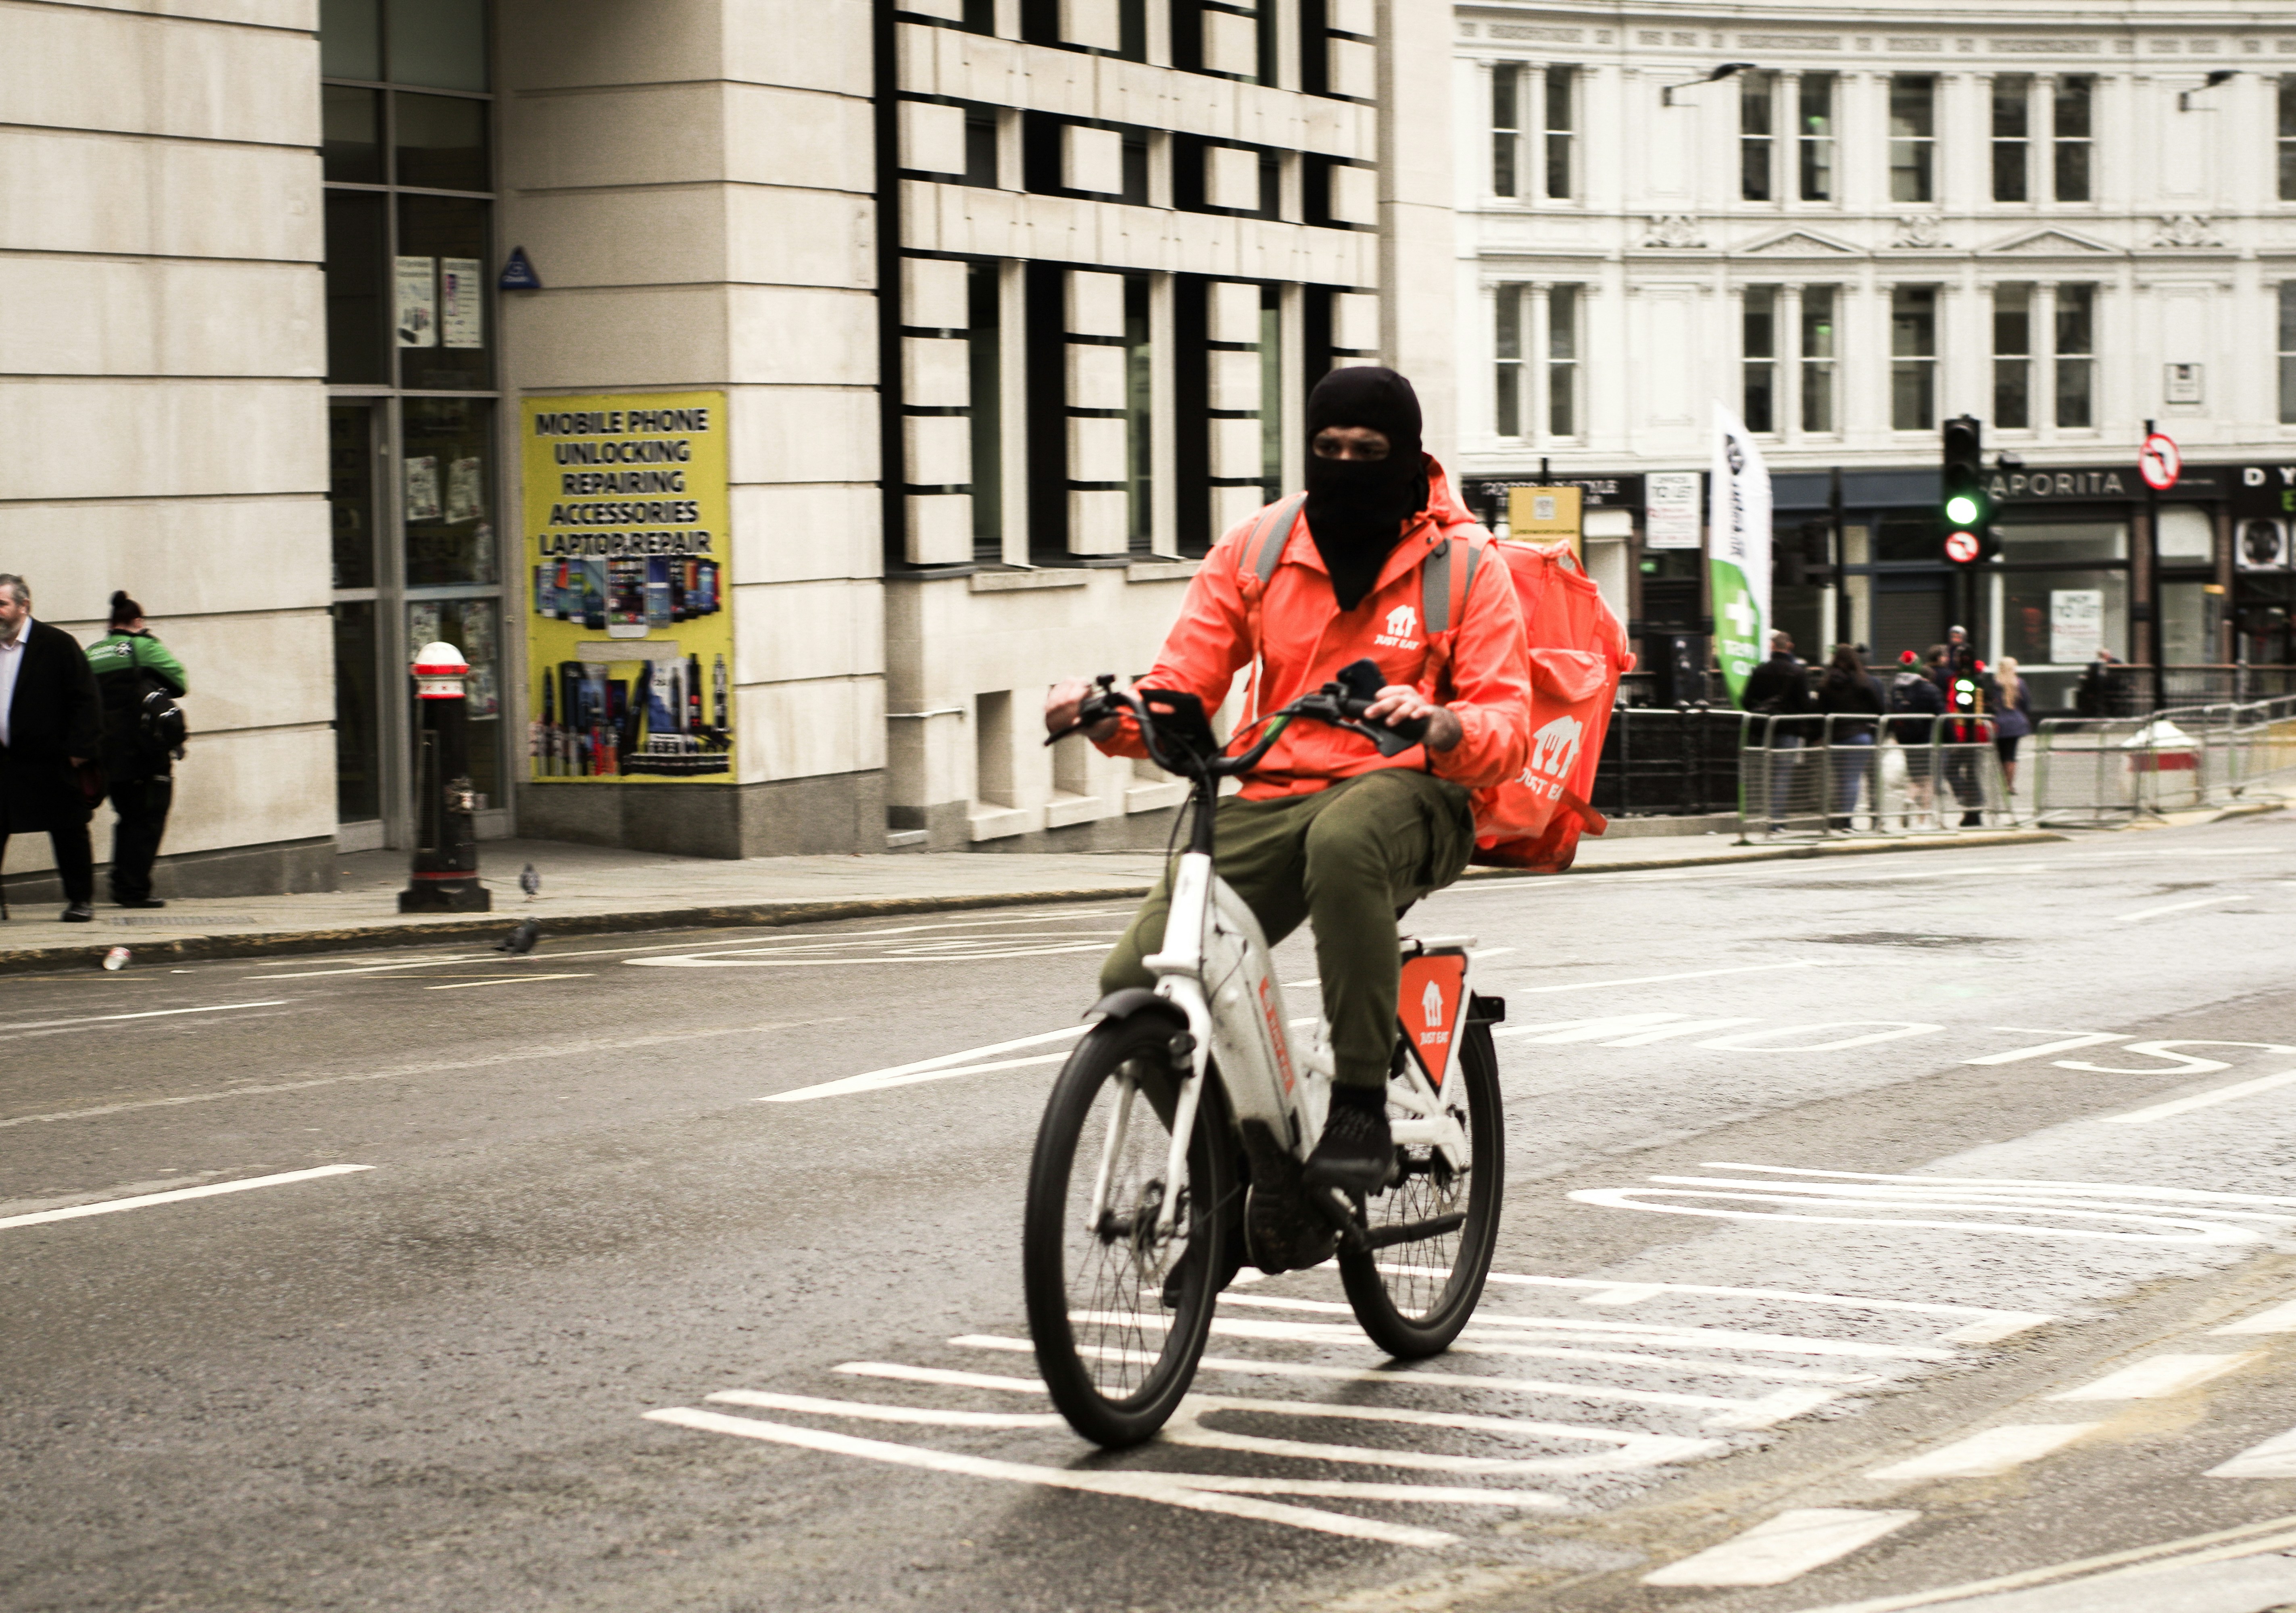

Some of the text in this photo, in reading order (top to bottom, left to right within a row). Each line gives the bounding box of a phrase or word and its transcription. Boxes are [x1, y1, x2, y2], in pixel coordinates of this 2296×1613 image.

[535, 408, 709, 436] MOBILE PHONE
[555, 440, 691, 466] UNLOCKING
[562, 470, 685, 496] REPAIRING
[549, 500, 699, 526] ACCESSORIES
[628, 530, 713, 554] REPAIR
[1374, 634, 1420, 650] JUST EAT
[1514, 767, 1548, 795] JUST
[1420, 1031, 1436, 1046] JUST
